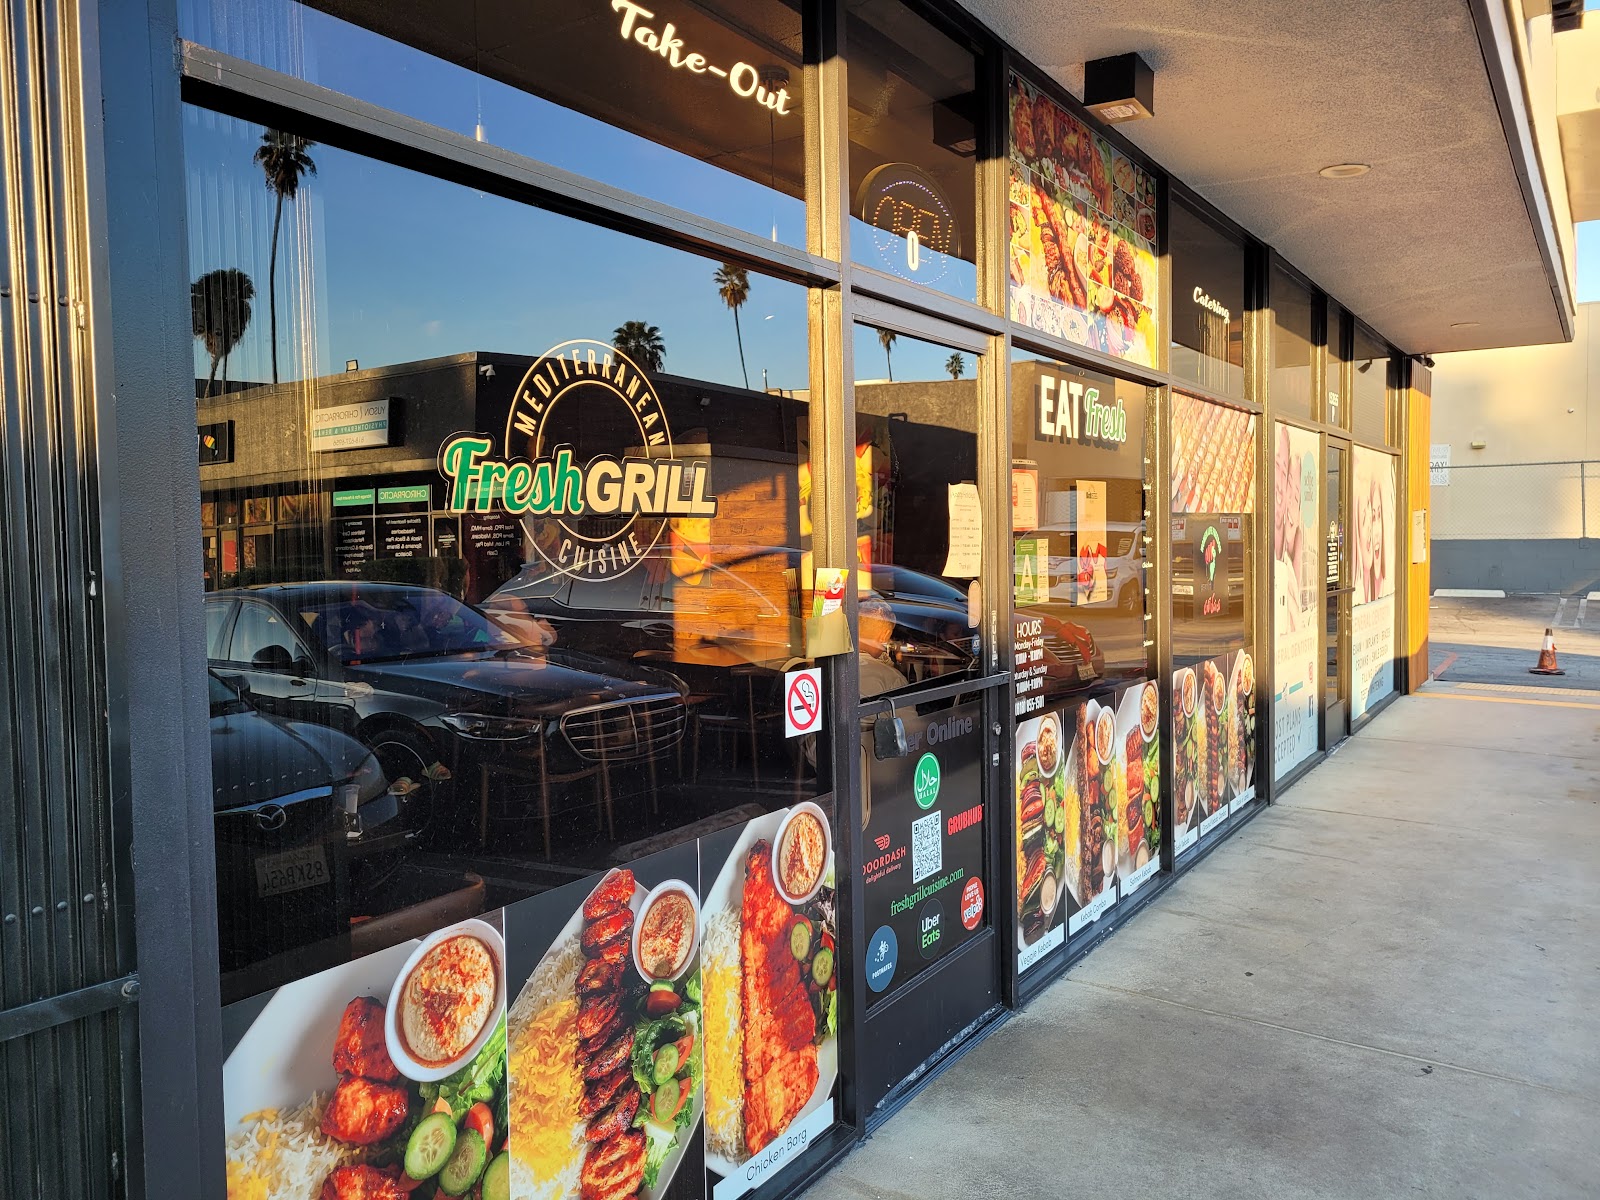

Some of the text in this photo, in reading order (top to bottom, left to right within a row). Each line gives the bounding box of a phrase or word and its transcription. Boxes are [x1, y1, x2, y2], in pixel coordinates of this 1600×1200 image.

[611, 0, 791, 115] Take-Out
[1193, 286, 1230, 324] Catering
[513, 349, 665, 446] MEDITERRANEAN
[1041, 374, 1127, 443] EAT Fresh
[443, 437, 717, 515] Fresh GRILL
[558, 532, 643, 574] CUISINE
[1014, 637, 1044, 651] Monday-Friday
[1016, 620, 1042, 639] HOURS
[1014, 668, 1029, 680] turday
[926, 716, 973, 746] Online
[1275, 716, 1285, 740] OST
[1275, 734, 1296, 764] CCEPTED
[918, 787, 936, 800] HALAL
[947, 804, 983, 836] GRUBHUB
[862, 845, 906, 876] DOORDASH
[890, 867, 964, 917] freshgrillcuisine.com
[921, 913, 941, 933] Uber
[921, 928, 941, 949] Eats
[871, 961, 893, 980] POSTMATES
[746, 1128, 808, 1181] Chicken Barg
